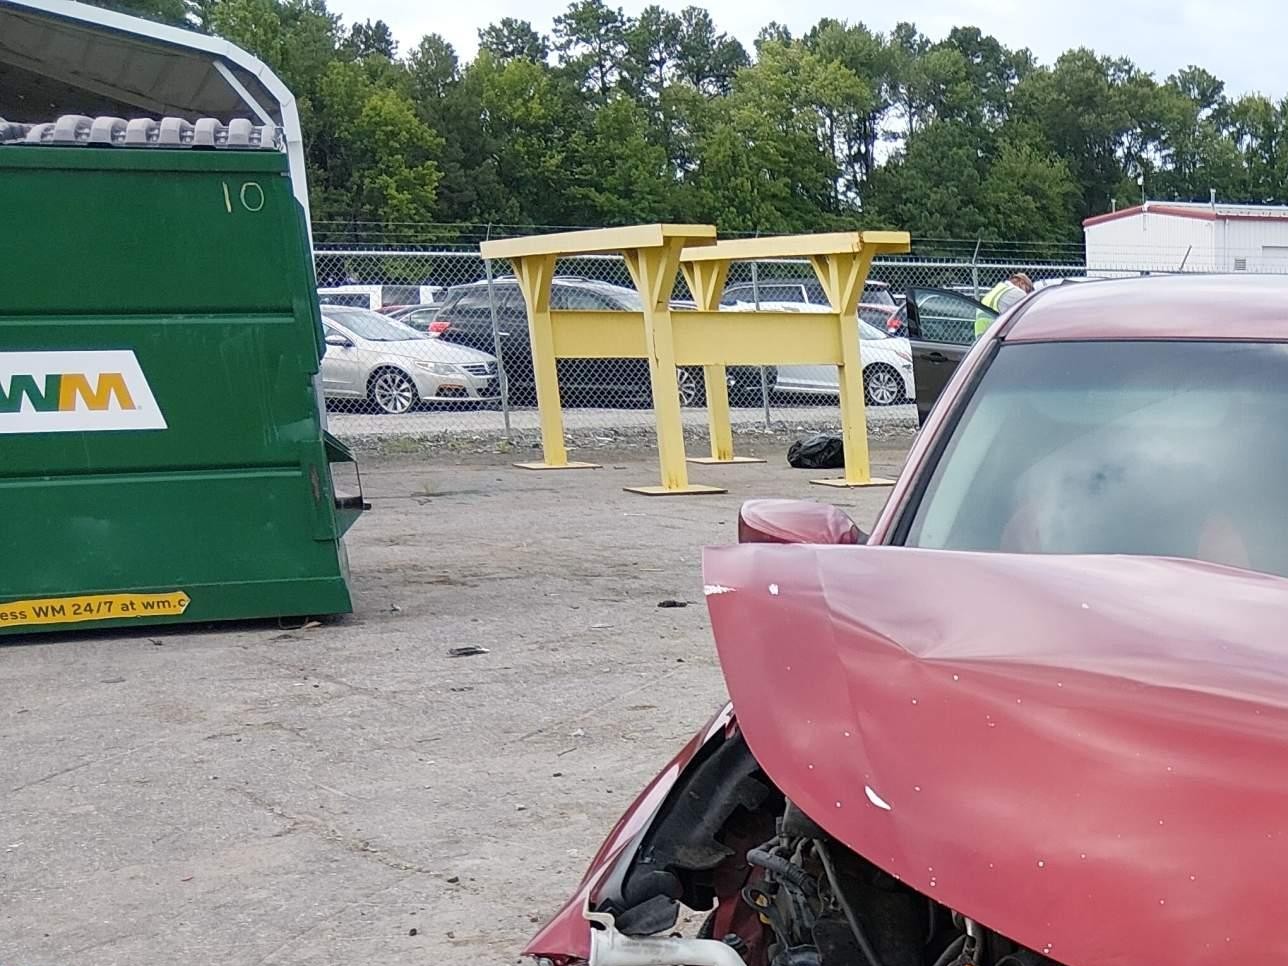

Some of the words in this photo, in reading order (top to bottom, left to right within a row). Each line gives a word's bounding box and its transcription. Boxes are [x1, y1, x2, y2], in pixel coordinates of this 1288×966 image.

[222, 181, 265, 213] 10
[0, 372, 137, 413] WM
[32, 604, 66, 618] WM
[72, 600, 114, 616] 24/7
[120, 600, 137, 612] at
